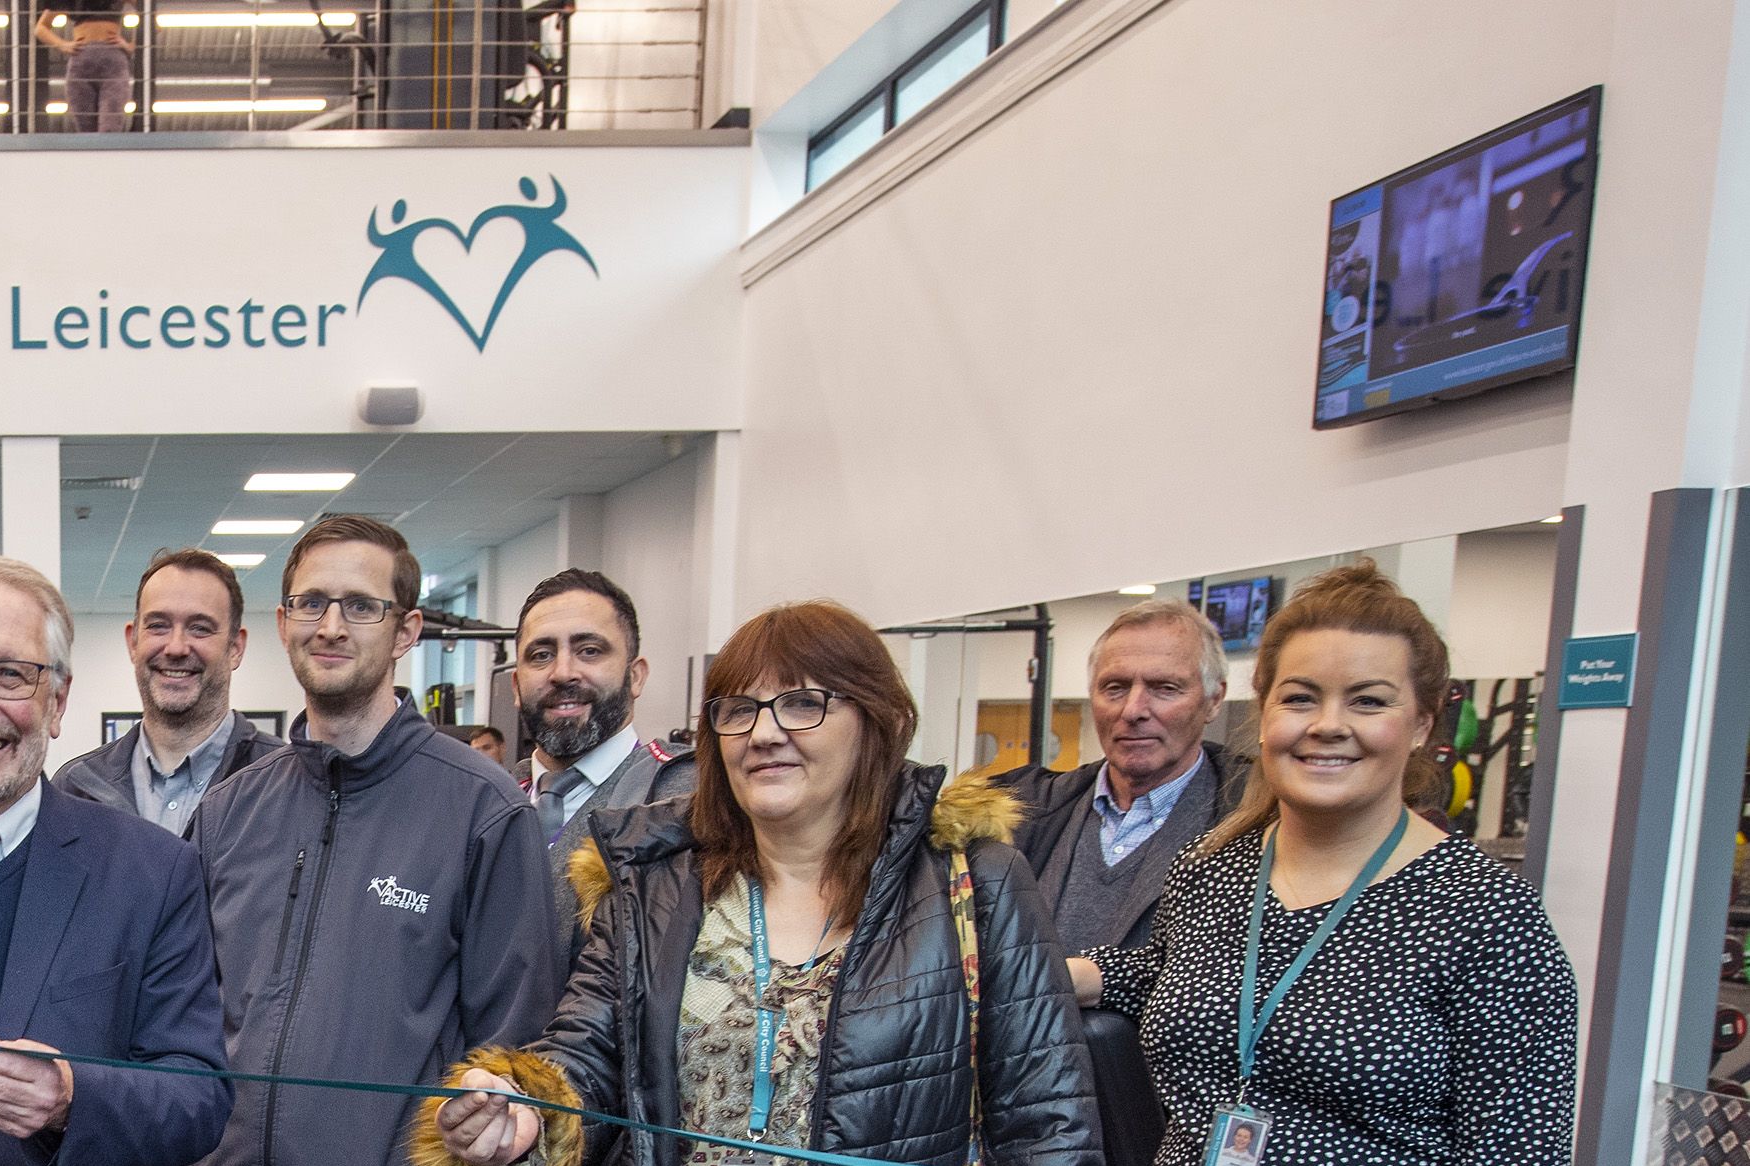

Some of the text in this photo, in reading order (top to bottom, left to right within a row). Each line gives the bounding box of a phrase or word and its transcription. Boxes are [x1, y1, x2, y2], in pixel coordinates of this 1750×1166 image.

[12, 286, 347, 349] Leicester
[380, 896, 428, 914] LEICESTER
[382, 887, 430, 906] ACTIVE
[752, 886, 767, 963] Leicester City Council
[760, 1020, 770, 1037] City
[759, 1039, 770, 1072] Council
